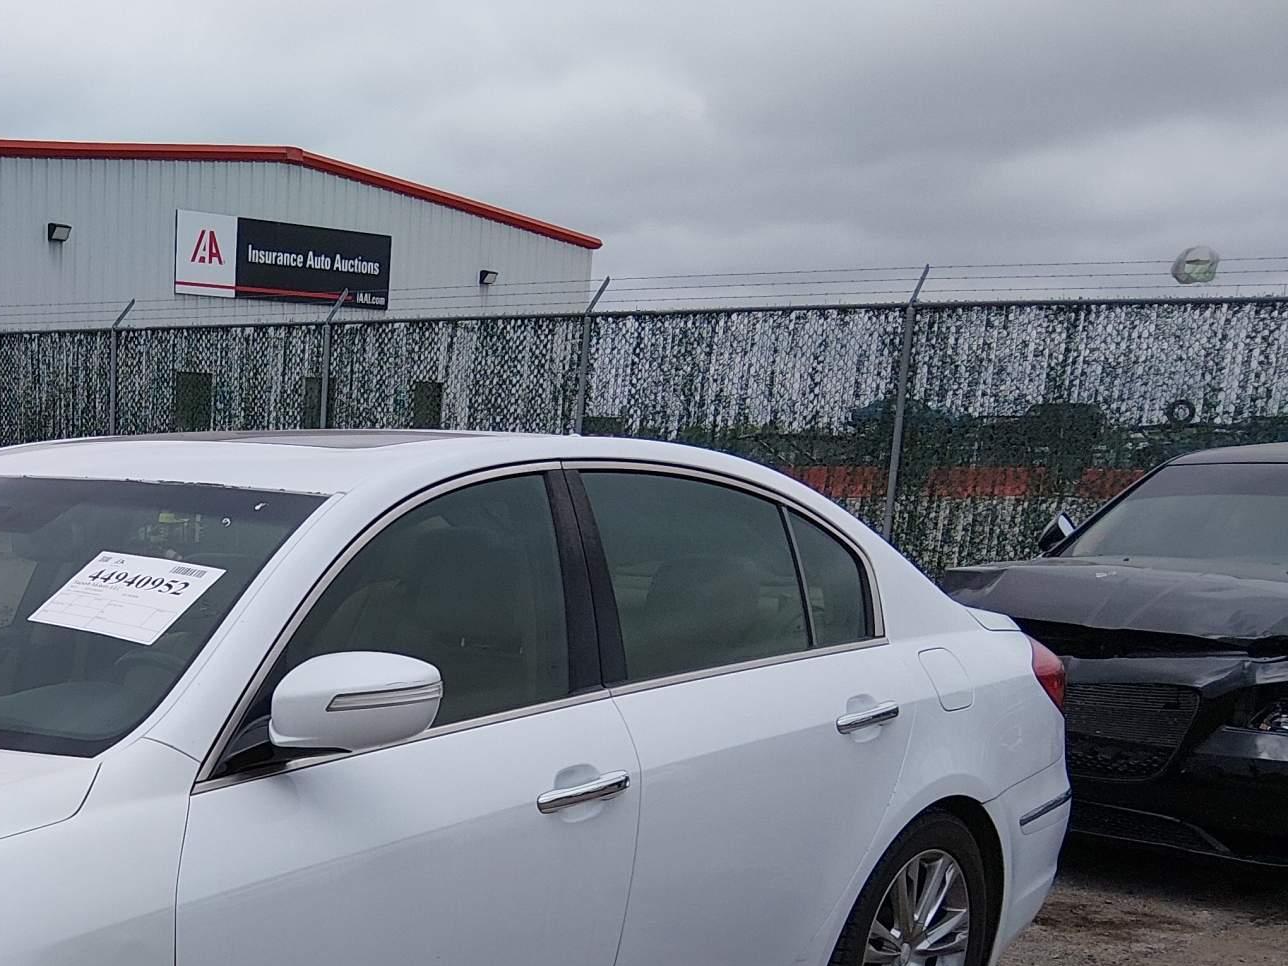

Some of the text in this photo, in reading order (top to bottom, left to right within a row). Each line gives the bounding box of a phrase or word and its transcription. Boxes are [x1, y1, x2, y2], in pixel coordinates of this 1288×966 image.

[248, 244, 380, 275] Insurance Auto Auctions
[88, 569, 190, 596] 44940952
